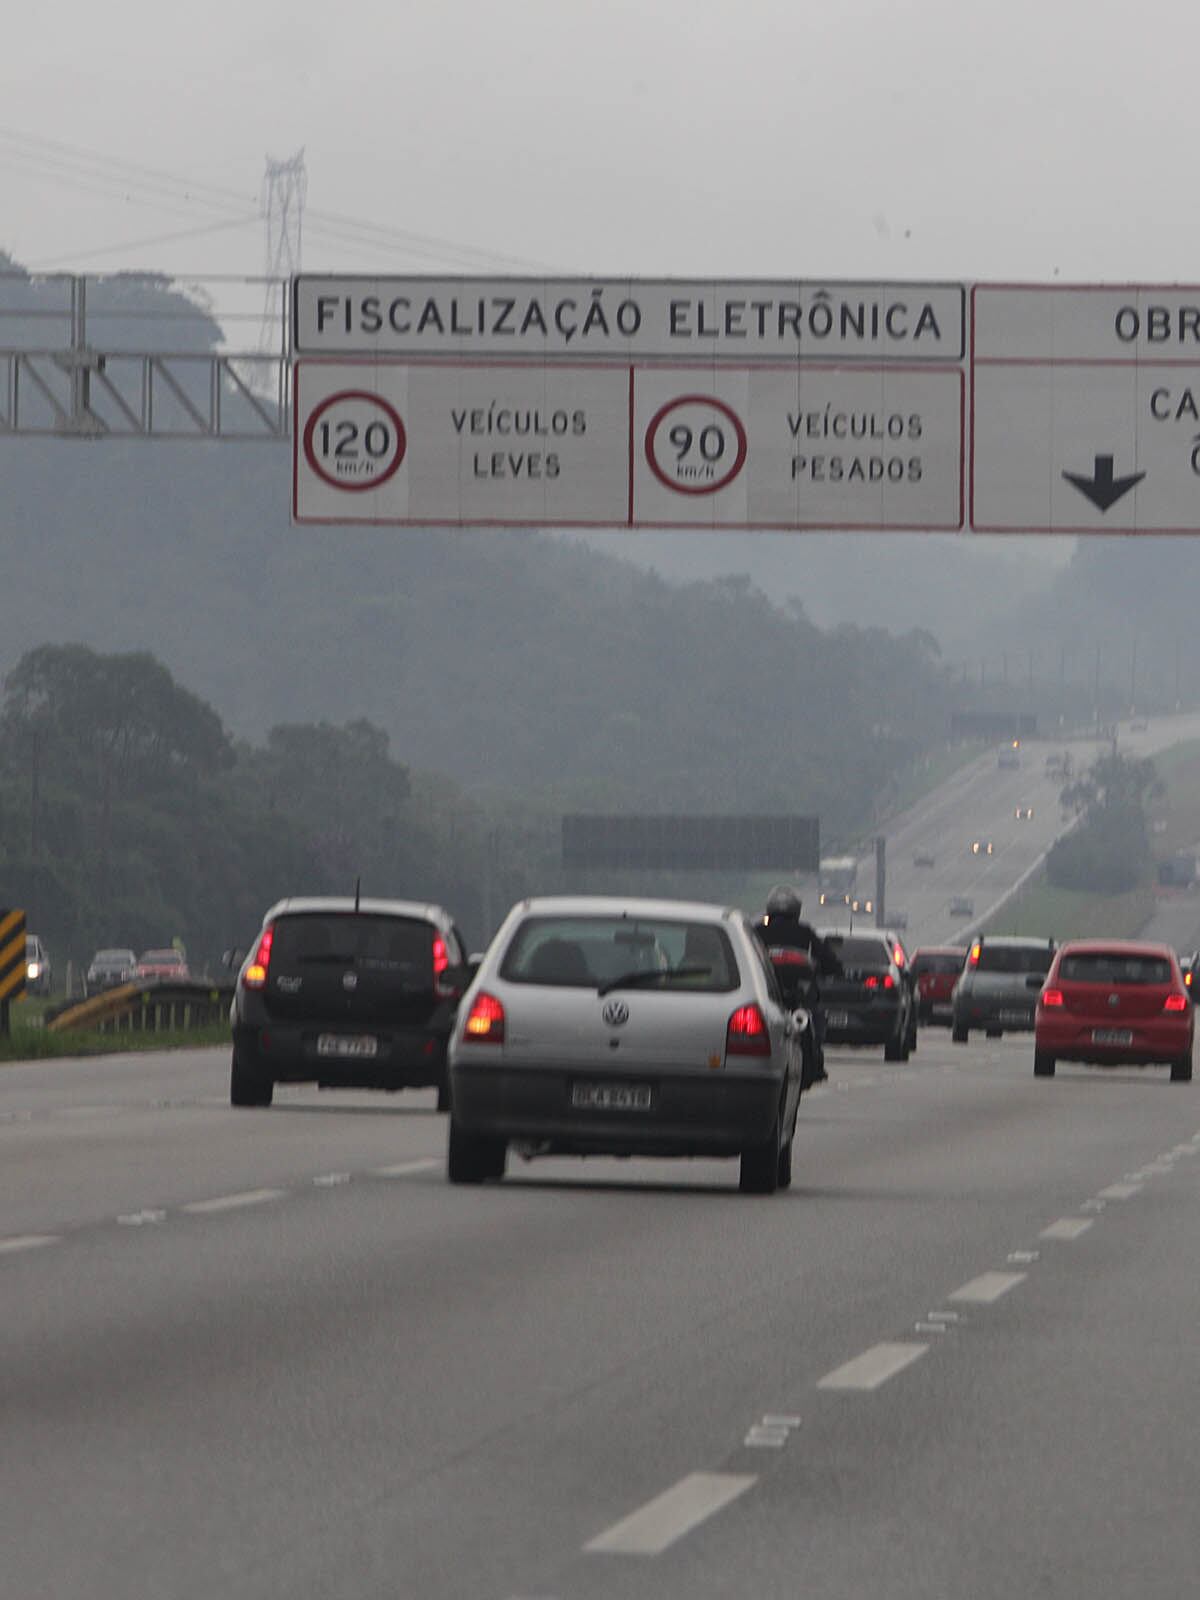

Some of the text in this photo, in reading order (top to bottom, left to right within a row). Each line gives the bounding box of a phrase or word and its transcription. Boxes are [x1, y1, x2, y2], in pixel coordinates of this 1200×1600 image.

[318, 289, 940, 344] FISCALIZAÇÃO ELETRÔNICA
[452, 401, 586, 434] VEÍCULOS
[788, 403, 922, 437] VEÍCULOS
[320, 421, 390, 460] 120
[670, 426, 724, 462] 90
[337, 460, 373, 473] km/h
[474, 454, 560, 477] LEVES
[677, 464, 714, 477] km/h
[792, 457, 922, 480] PESADOS
